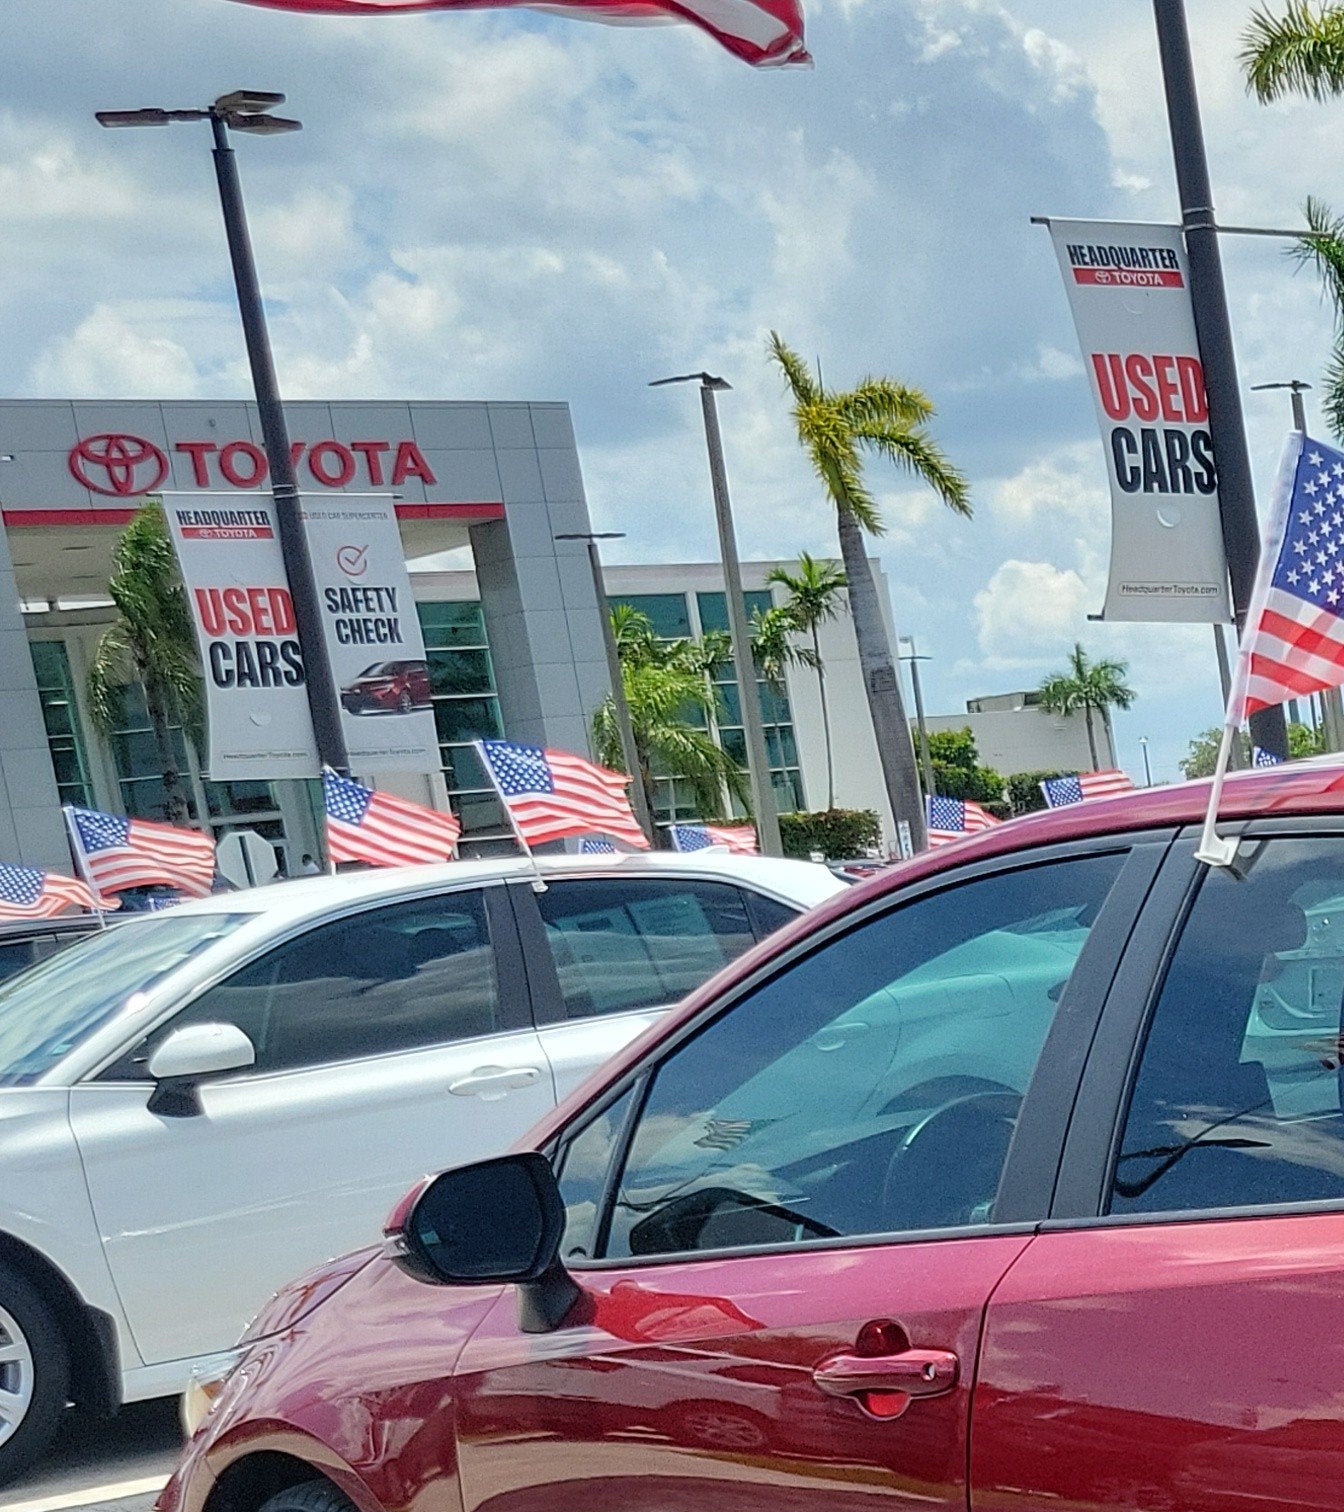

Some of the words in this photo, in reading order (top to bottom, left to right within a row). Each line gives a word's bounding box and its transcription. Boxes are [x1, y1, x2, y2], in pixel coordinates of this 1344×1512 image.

[1066, 244, 1180, 270] HEADQUARTER
[1115, 272, 1164, 286] TOYOTA
[1091, 353, 1209, 424] USED
[1111, 426, 1219, 495] CARS
[176, 510, 271, 528] HEADQUARTER
[215, 529, 257, 538] TOYOTA
[194, 587, 299, 637] USED
[324, 586, 398, 614] SAFETY
[335, 617, 404, 645] CHECK
[209, 640, 306, 689] CARS
